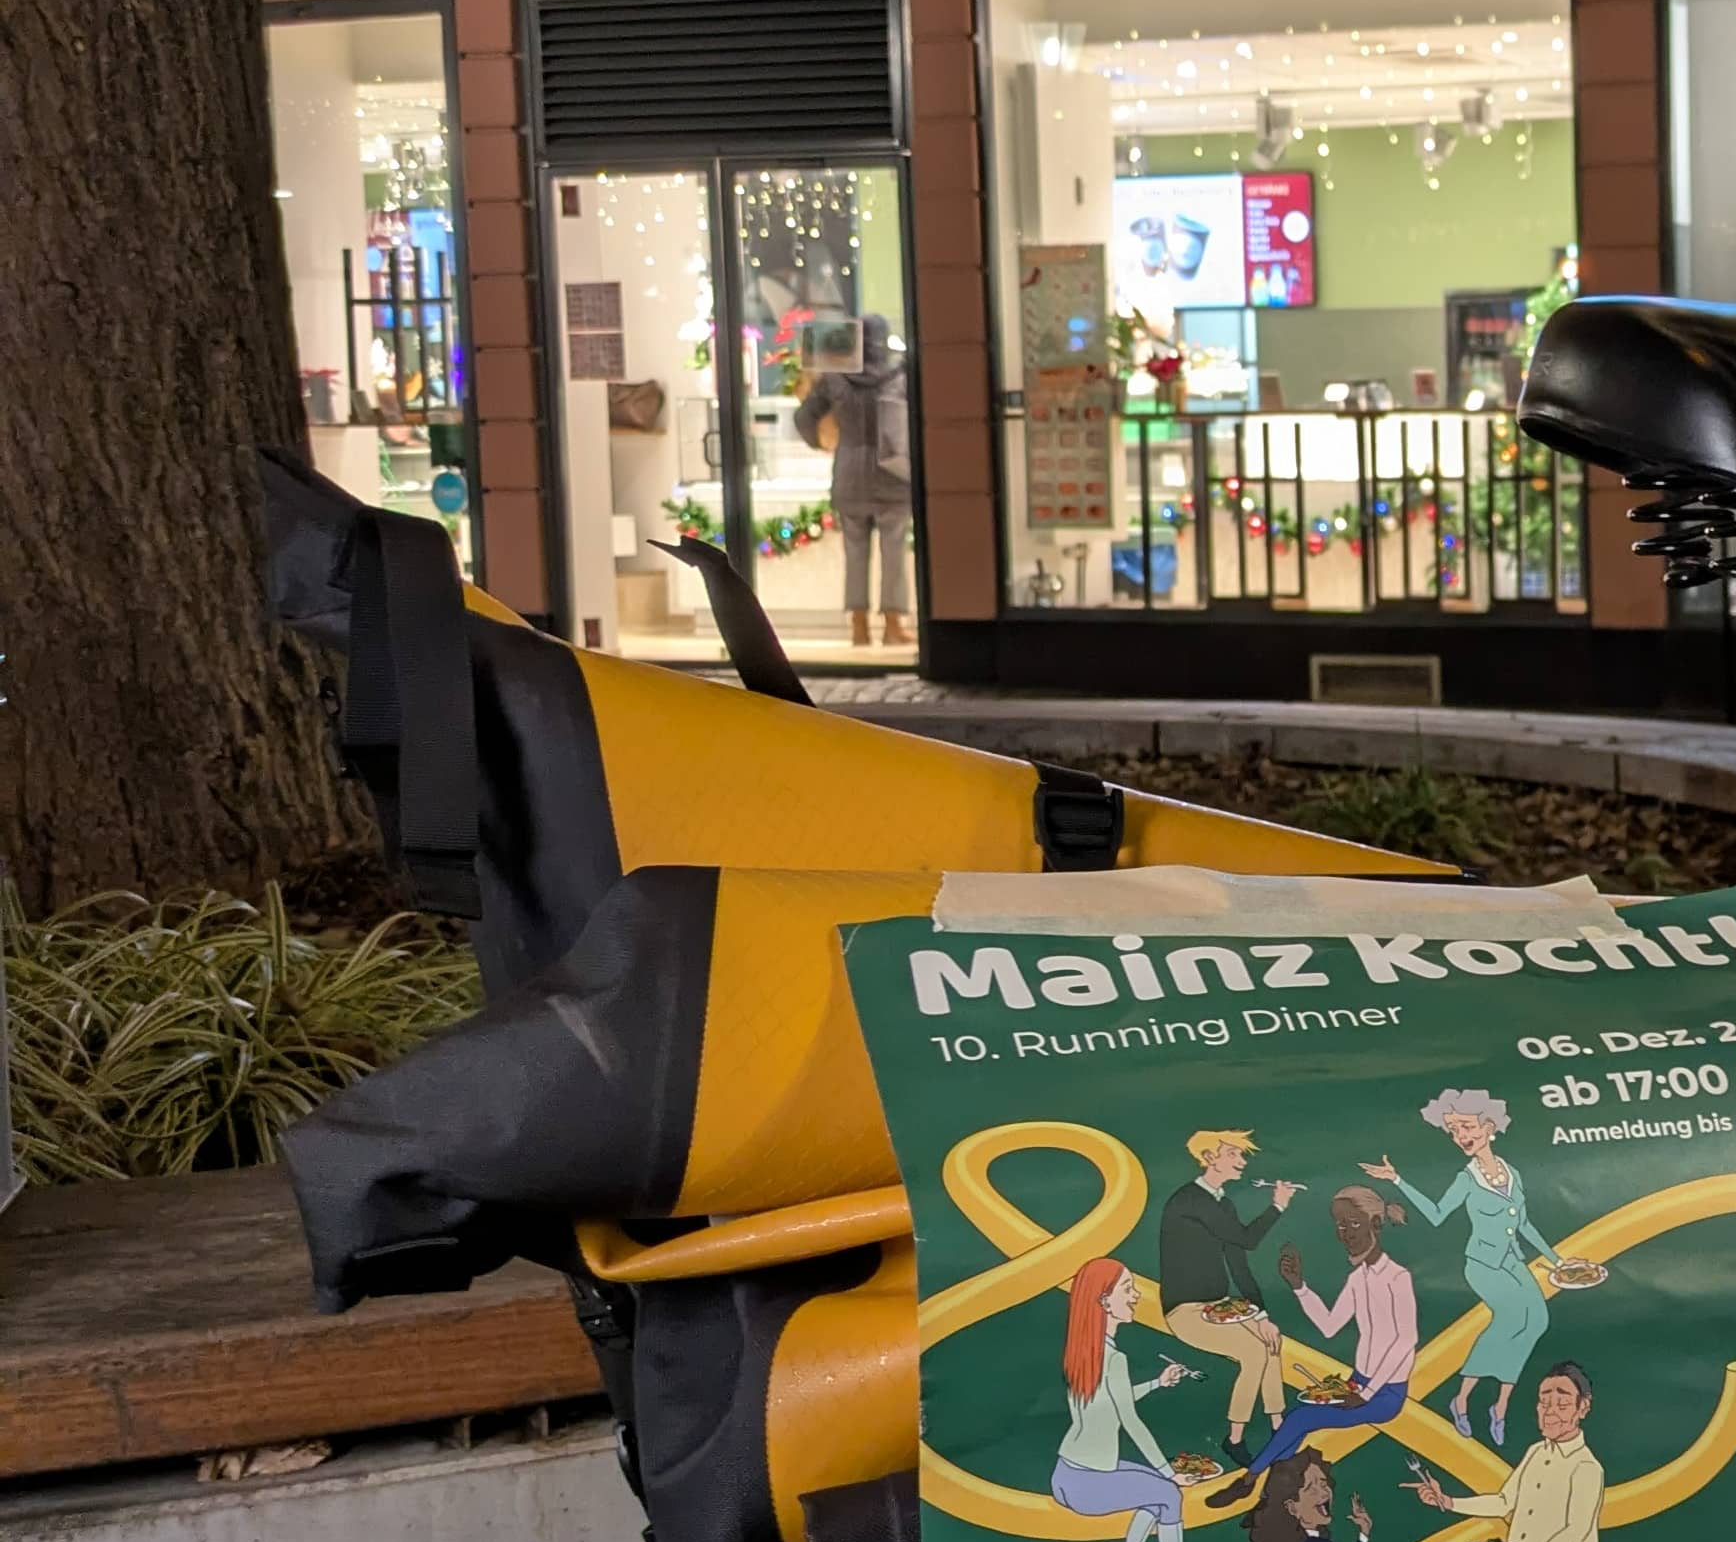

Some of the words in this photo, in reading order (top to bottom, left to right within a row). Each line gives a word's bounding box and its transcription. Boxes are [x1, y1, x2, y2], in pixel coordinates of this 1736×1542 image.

[909, 934, 1330, 1015] Mainz
[930, 1035, 1000, 1062] 10.
[1012, 1016, 1231, 1058] Running
[1241, 1004, 1404, 1036] Dinner
[1517, 1034, 1594, 1061] 06.
[1599, 1029, 1706, 1054] Dez.
[1538, 1074, 1600, 1109] ab
[1606, 1063, 1729, 1103] 17:00
[1551, 1114, 1693, 1146] Anmeldung
[1697, 1113, 1733, 1135] bis
